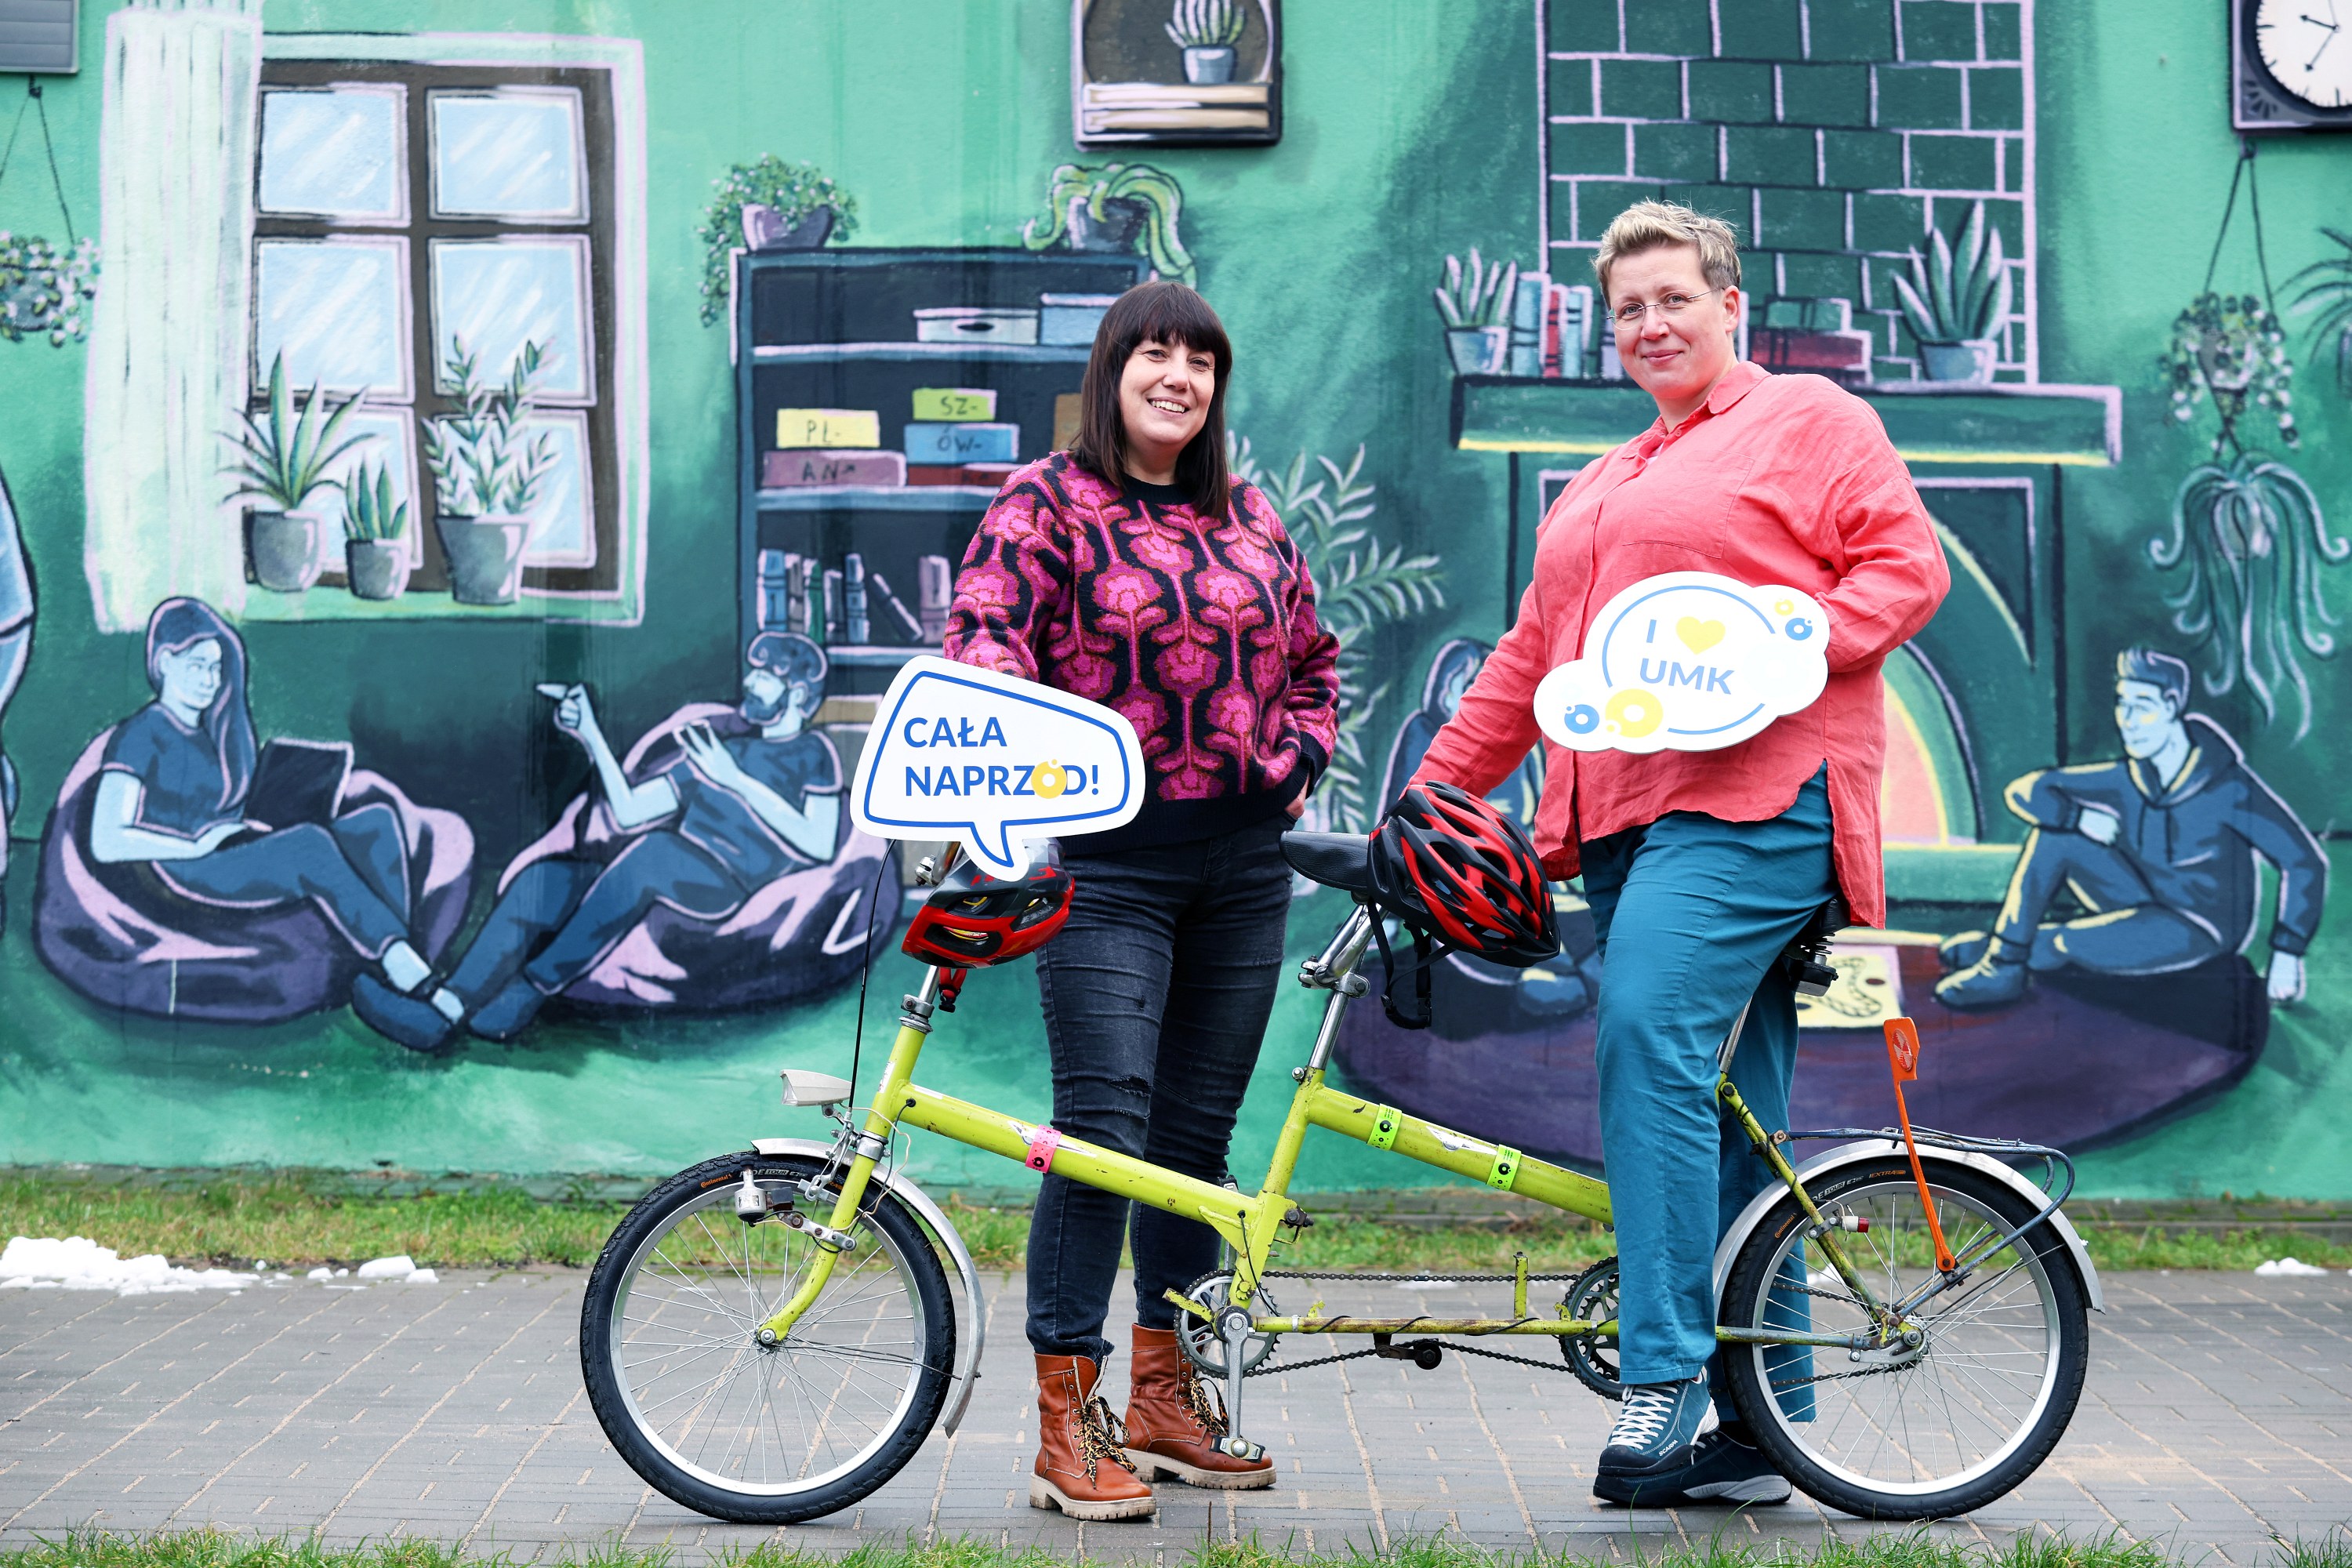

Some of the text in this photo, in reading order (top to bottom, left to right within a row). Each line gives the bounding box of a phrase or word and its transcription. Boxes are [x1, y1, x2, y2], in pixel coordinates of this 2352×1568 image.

[1646, 619, 1657, 644] I
[1639, 657, 1735, 695] UMK
[903, 716, 1008, 748] CAŁA
[1658, 1439, 1679, 1457] SCARPA
